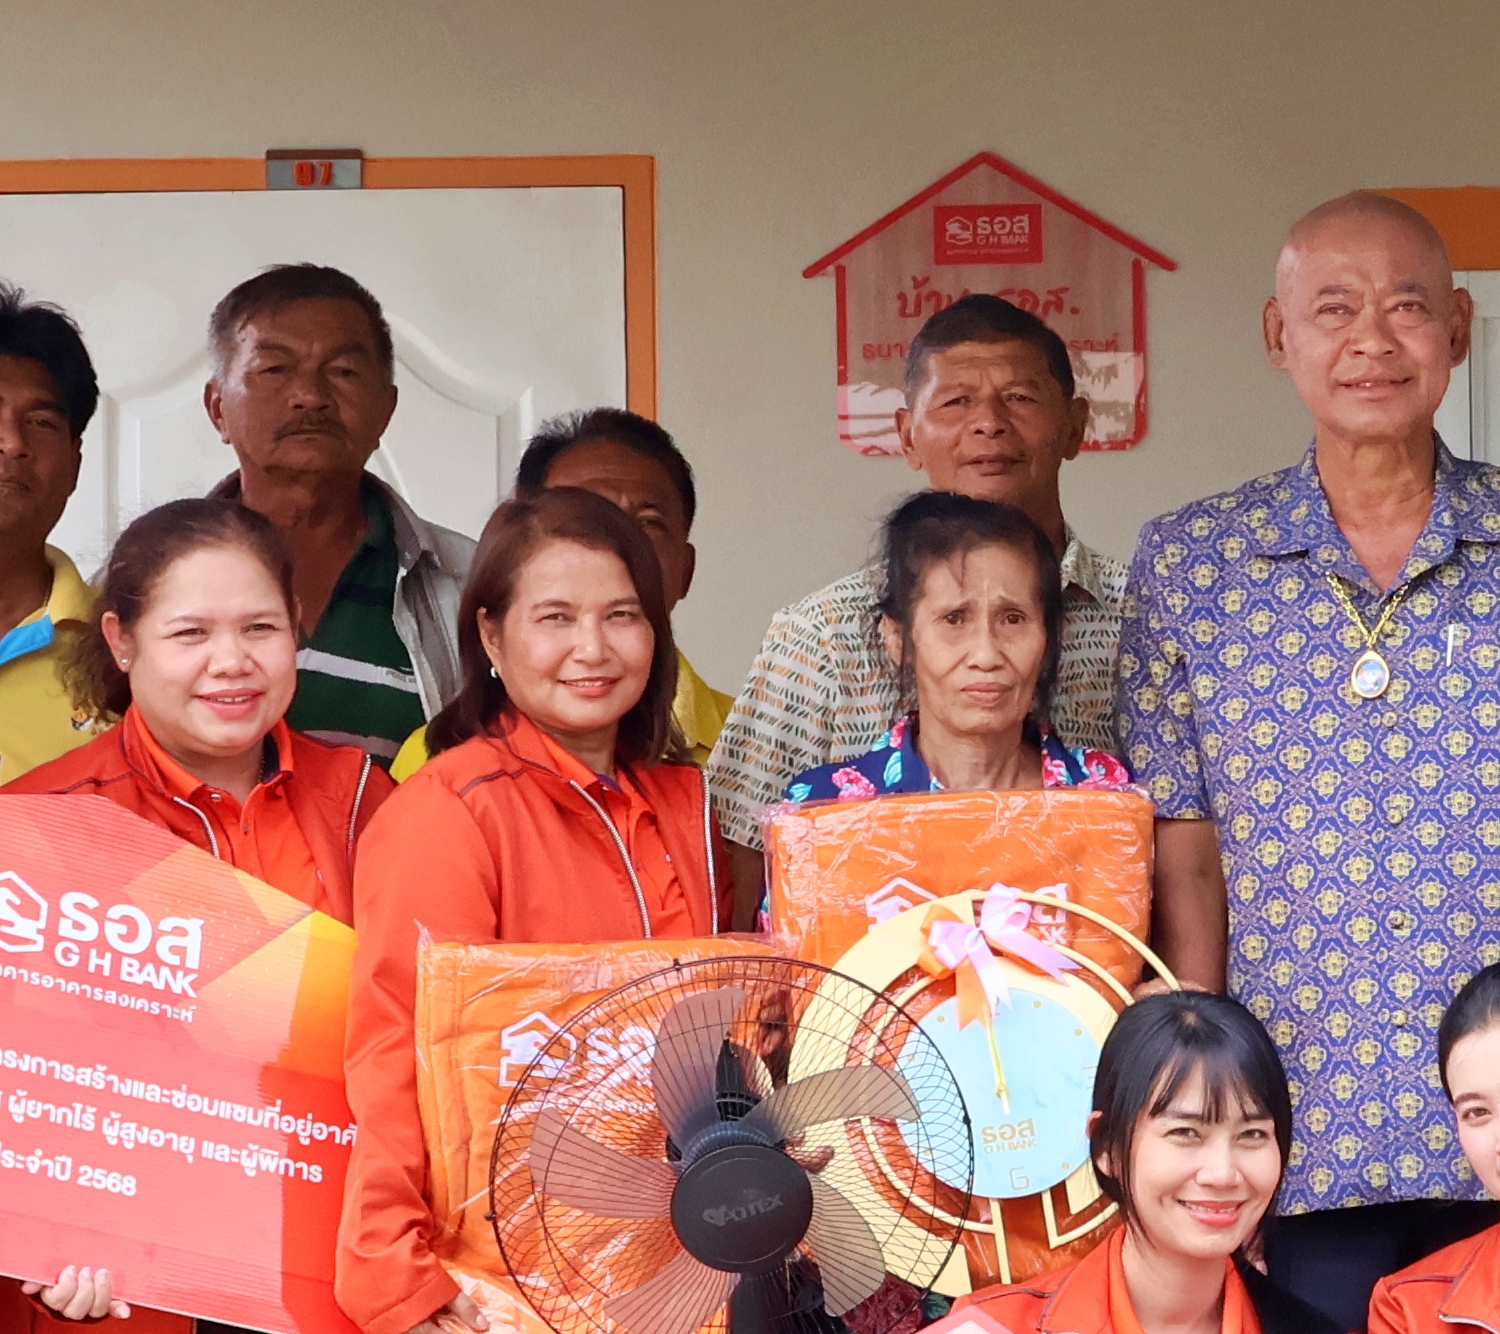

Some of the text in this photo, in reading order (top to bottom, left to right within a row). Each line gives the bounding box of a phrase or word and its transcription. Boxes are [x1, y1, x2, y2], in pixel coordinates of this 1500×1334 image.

[293, 161, 333, 186] 97
[976, 214, 1029, 234] ธอส
[976, 234, 1028, 245] G H BANK
[57, 891, 204, 969] ธอส
[54, 941, 198, 998] G H BANK
[7, 1089, 97, 1132] ผู้ยากไร้
[102, 1111, 195, 1163] ผู้สูงอายุ
[201, 1139, 324, 1184] และผู้พิการ
[981, 1118, 1036, 1145] ธอส
[1008, 1139, 1037, 1152] BANK
[76, 1164, 137, 1197] 2568
